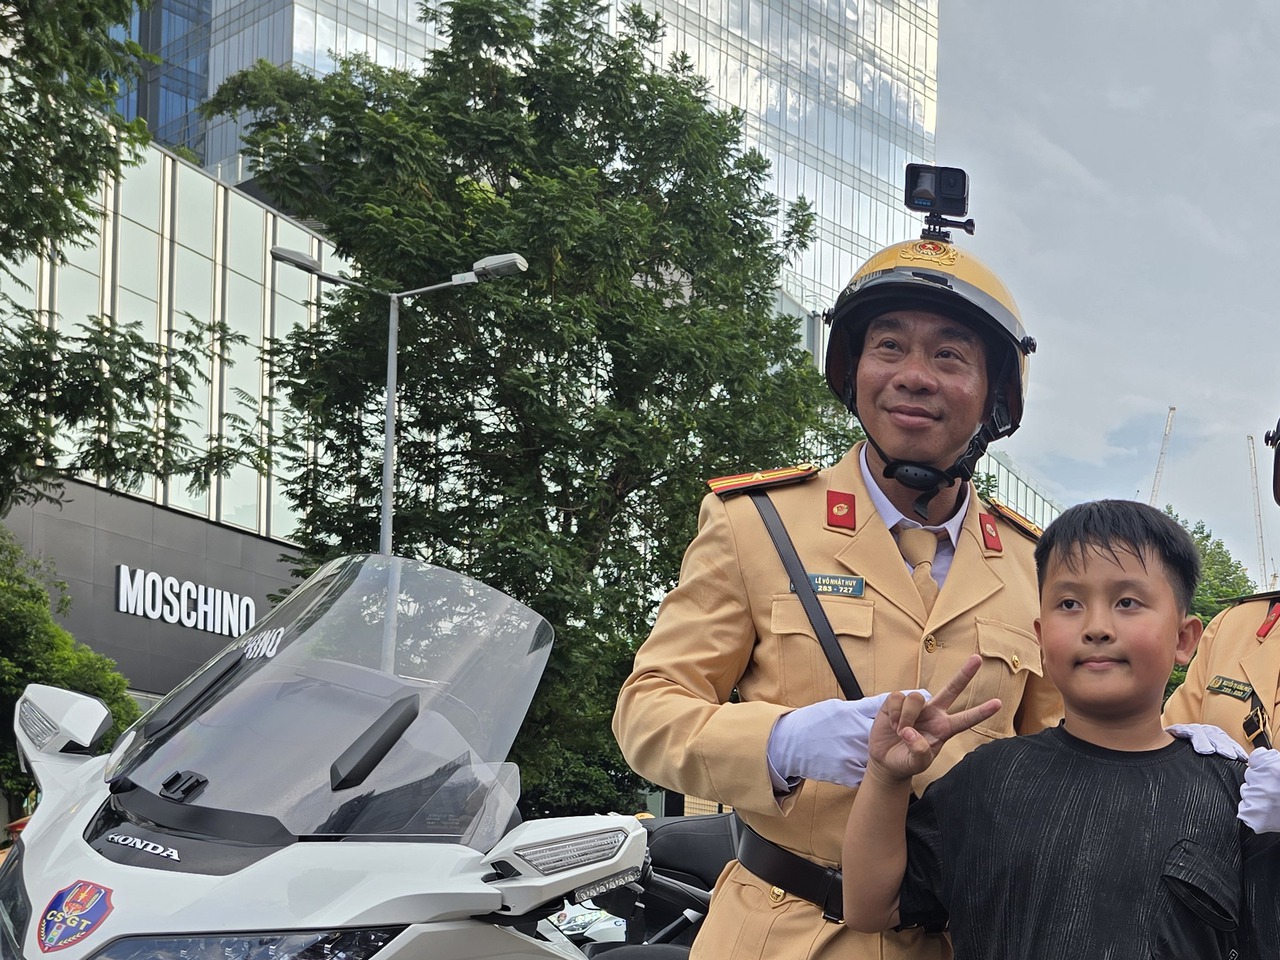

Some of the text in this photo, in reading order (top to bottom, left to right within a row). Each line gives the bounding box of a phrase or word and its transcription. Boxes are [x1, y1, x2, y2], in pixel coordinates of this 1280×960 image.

[118, 564, 256, 638] MOSCHINO
[106, 832, 181, 862] HONDA
[46, 910, 92, 931] CSGT
